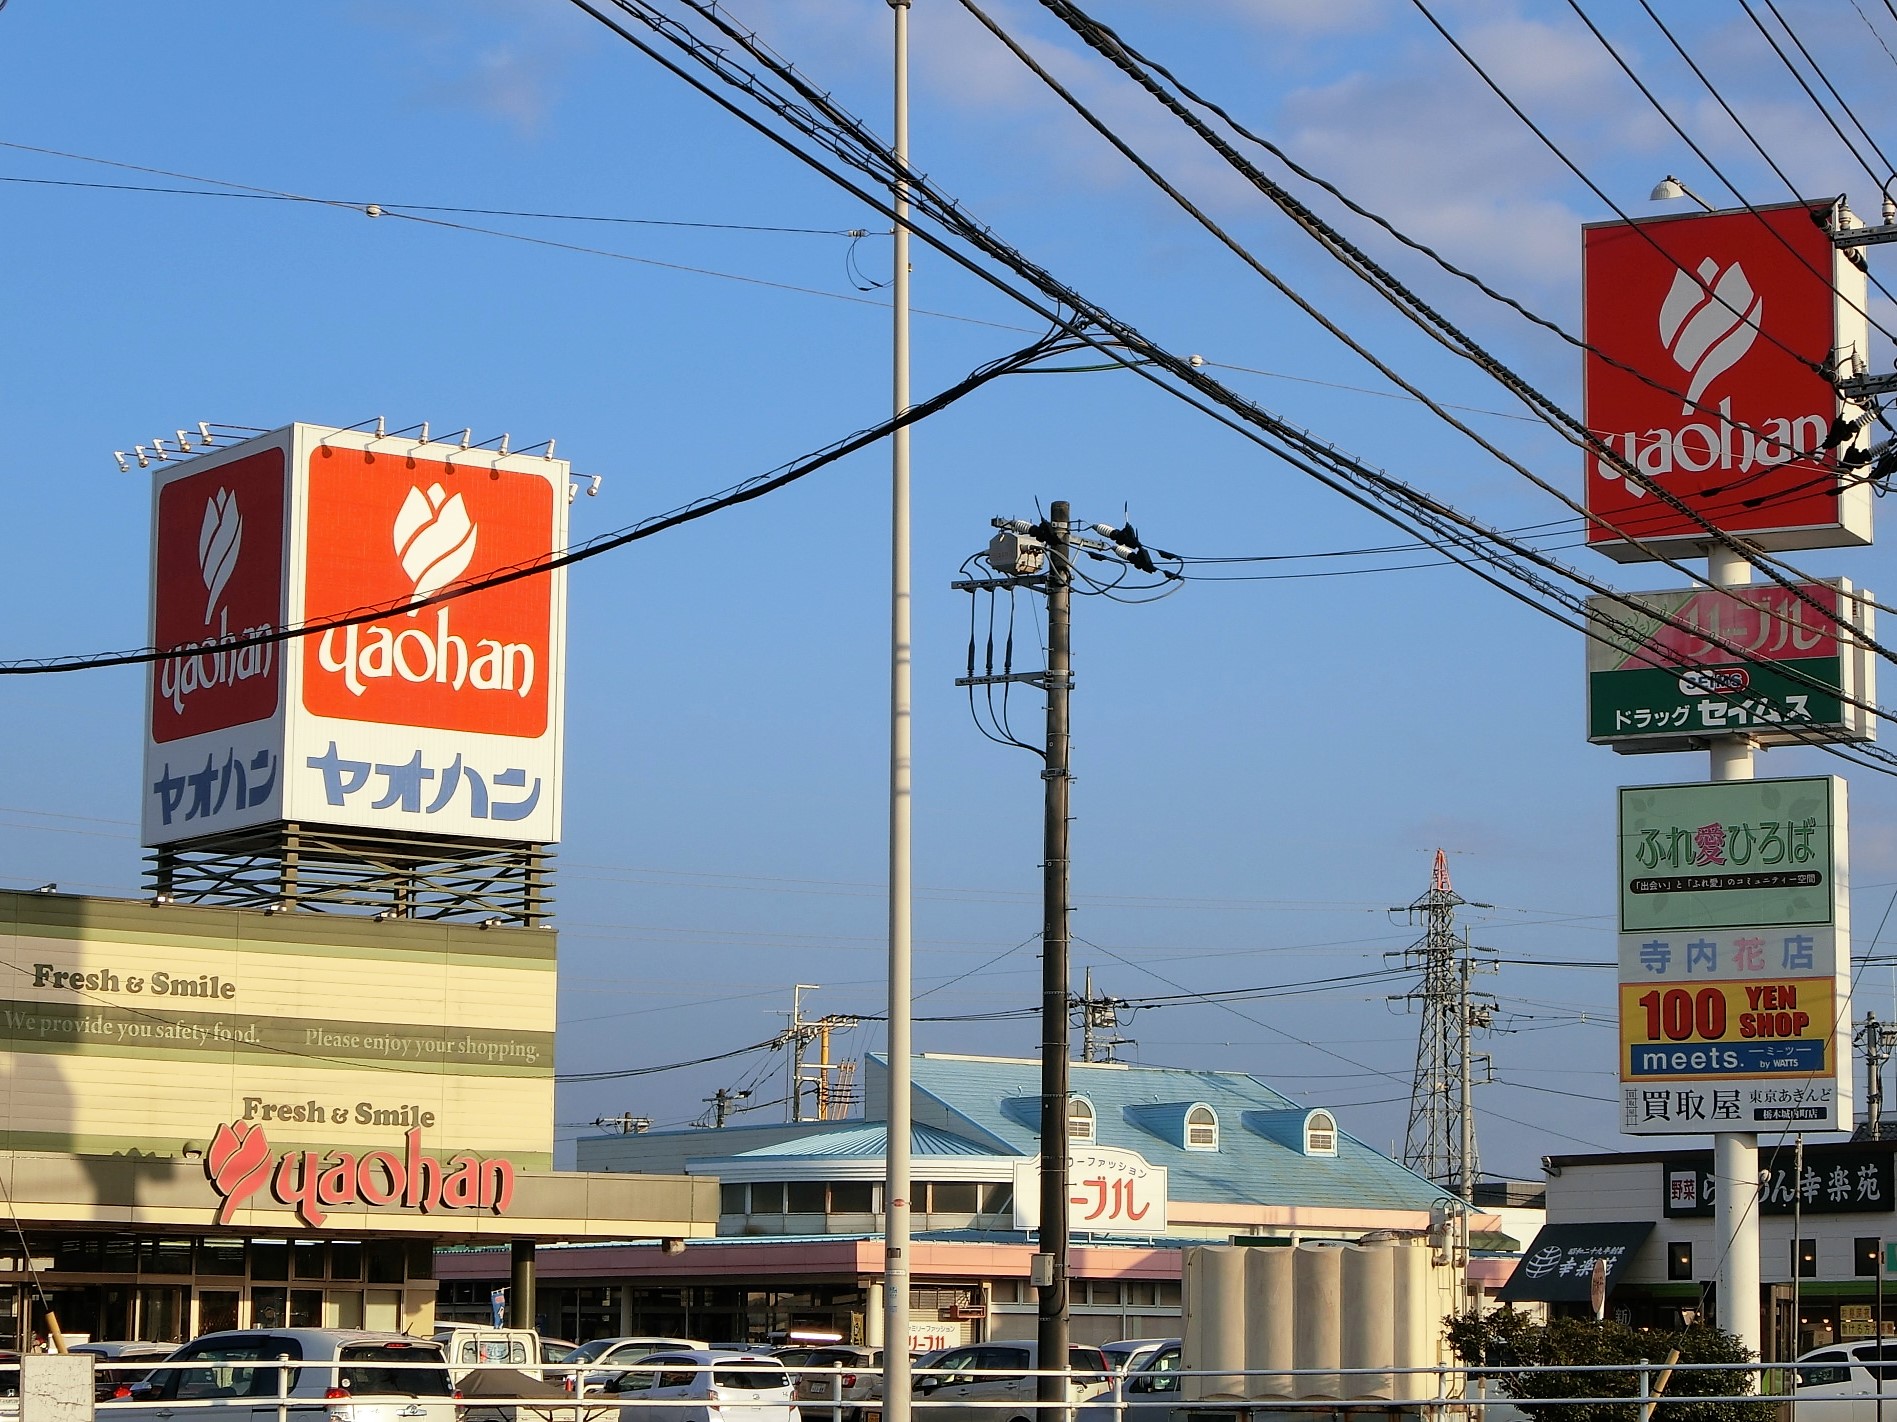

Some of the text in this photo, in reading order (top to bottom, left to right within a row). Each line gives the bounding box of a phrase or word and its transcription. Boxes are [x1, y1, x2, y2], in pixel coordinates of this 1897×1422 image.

[1598, 396, 1827, 498] yaohan
[161, 605, 273, 715] yaohan
[317, 606, 535, 698] yaohan
[1616, 695, 1812, 731] ドラッグ セイムス
[153, 747, 277, 826] ヤオハン
[306, 740, 541, 821] ヤオハン
[1635, 816, 1816, 869] ふれ愛ひろば
[1639, 934, 1815, 975] 寺内花店
[33, 963, 236, 1000] Fresh & Smile
[1745, 985, 1797, 1011] YEN
[1639, 987, 1727, 1041] 100
[1739, 1012, 1809, 1038] SHOP
[4, 1010, 540, 1063] We provide you safety food. Please enjoy your shopping.
[1643, 1047, 1745, 1070] meets.
[1760, 1058, 1799, 1069] by WATTS
[241, 1097, 435, 1127] Fresh & Smile
[1642, 1089, 1742, 1122] 買取屋
[1749, 1088, 1832, 1104] 東京あきんど
[273, 1127, 514, 1227] yaohan
[1671, 1179, 1695, 1200] 野菜
[1070, 1176, 1150, 1221] ーブル
